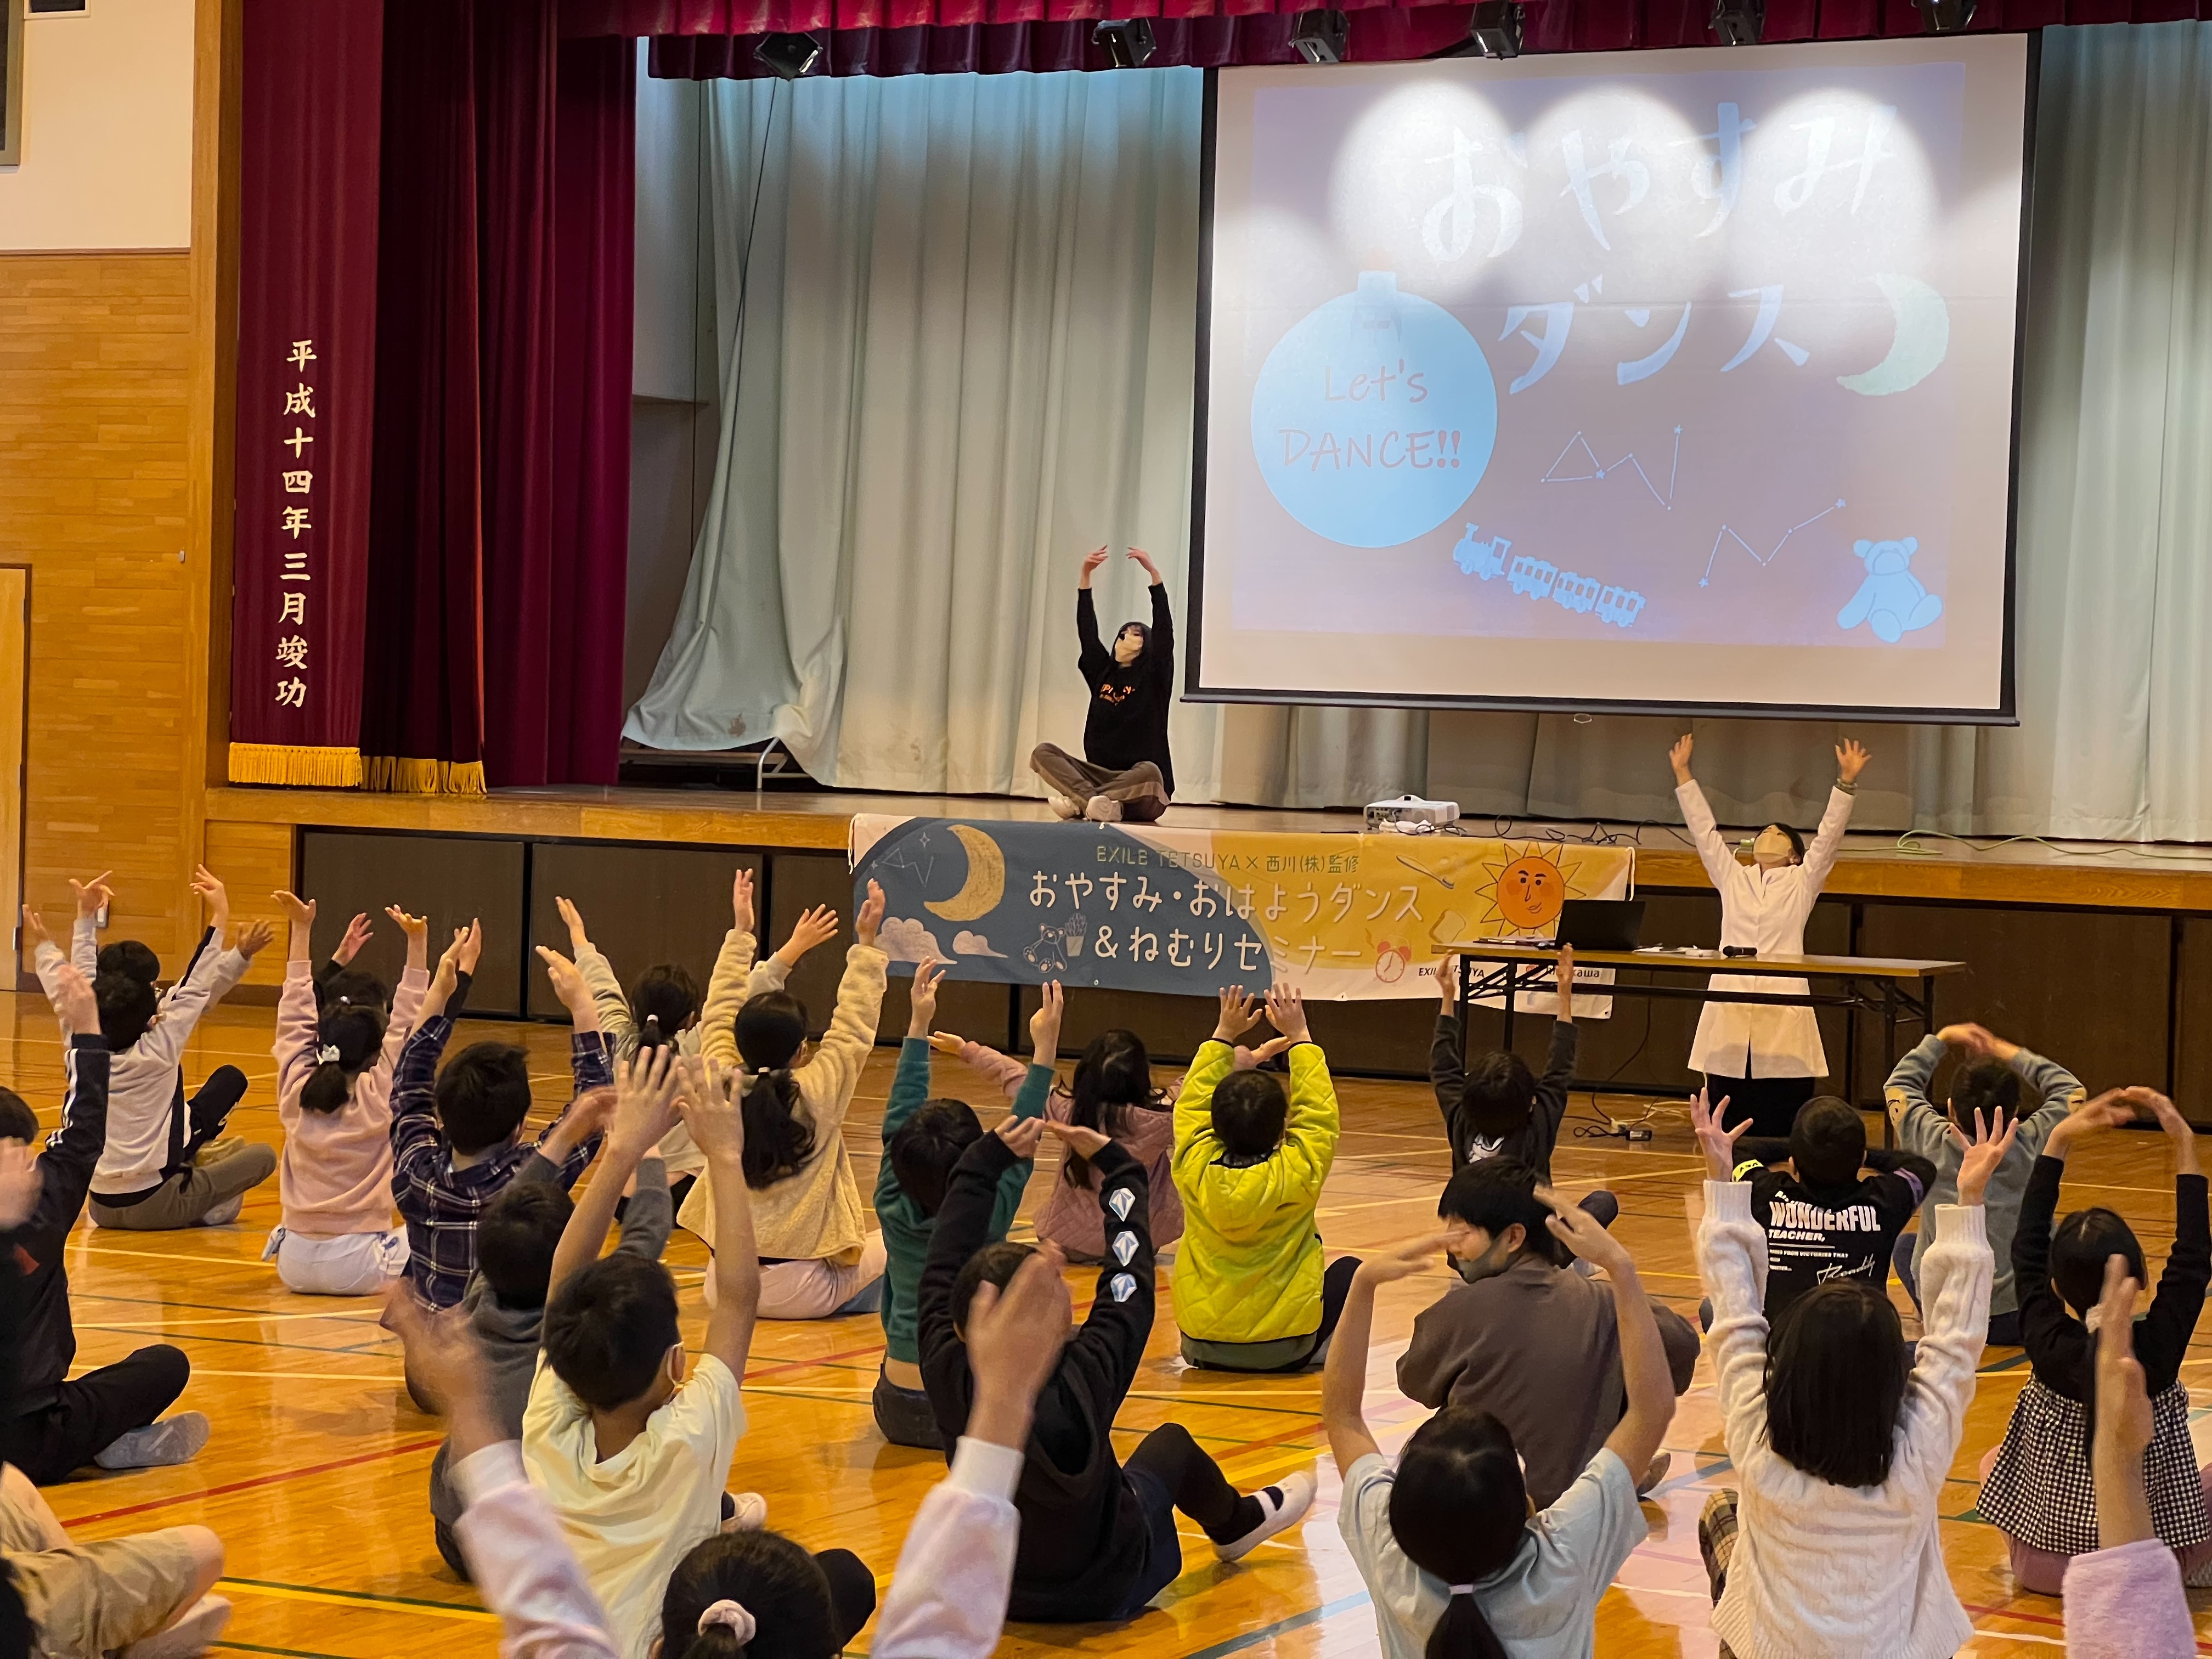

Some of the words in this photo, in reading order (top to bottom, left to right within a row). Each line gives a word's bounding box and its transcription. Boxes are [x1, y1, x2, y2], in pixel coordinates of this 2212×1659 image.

[1421, 102, 1898, 261] おやすみ
[1498, 273, 1810, 395] ダンス
[1325, 358, 1429, 403] Let's
[1278, 430, 1461, 472] DANCE!!
[275, 339, 317, 708] 平成十四年三月竣功
[1097, 845, 1148, 866] EXILE
[1158, 850, 1240, 871] TETSUYA
[1029, 870, 1423, 923] おやすみ・おはようダンス
[1768, 1229, 1826, 1242] TEACHER,
[1769, 1200, 1881, 1232] WONDERFUL
